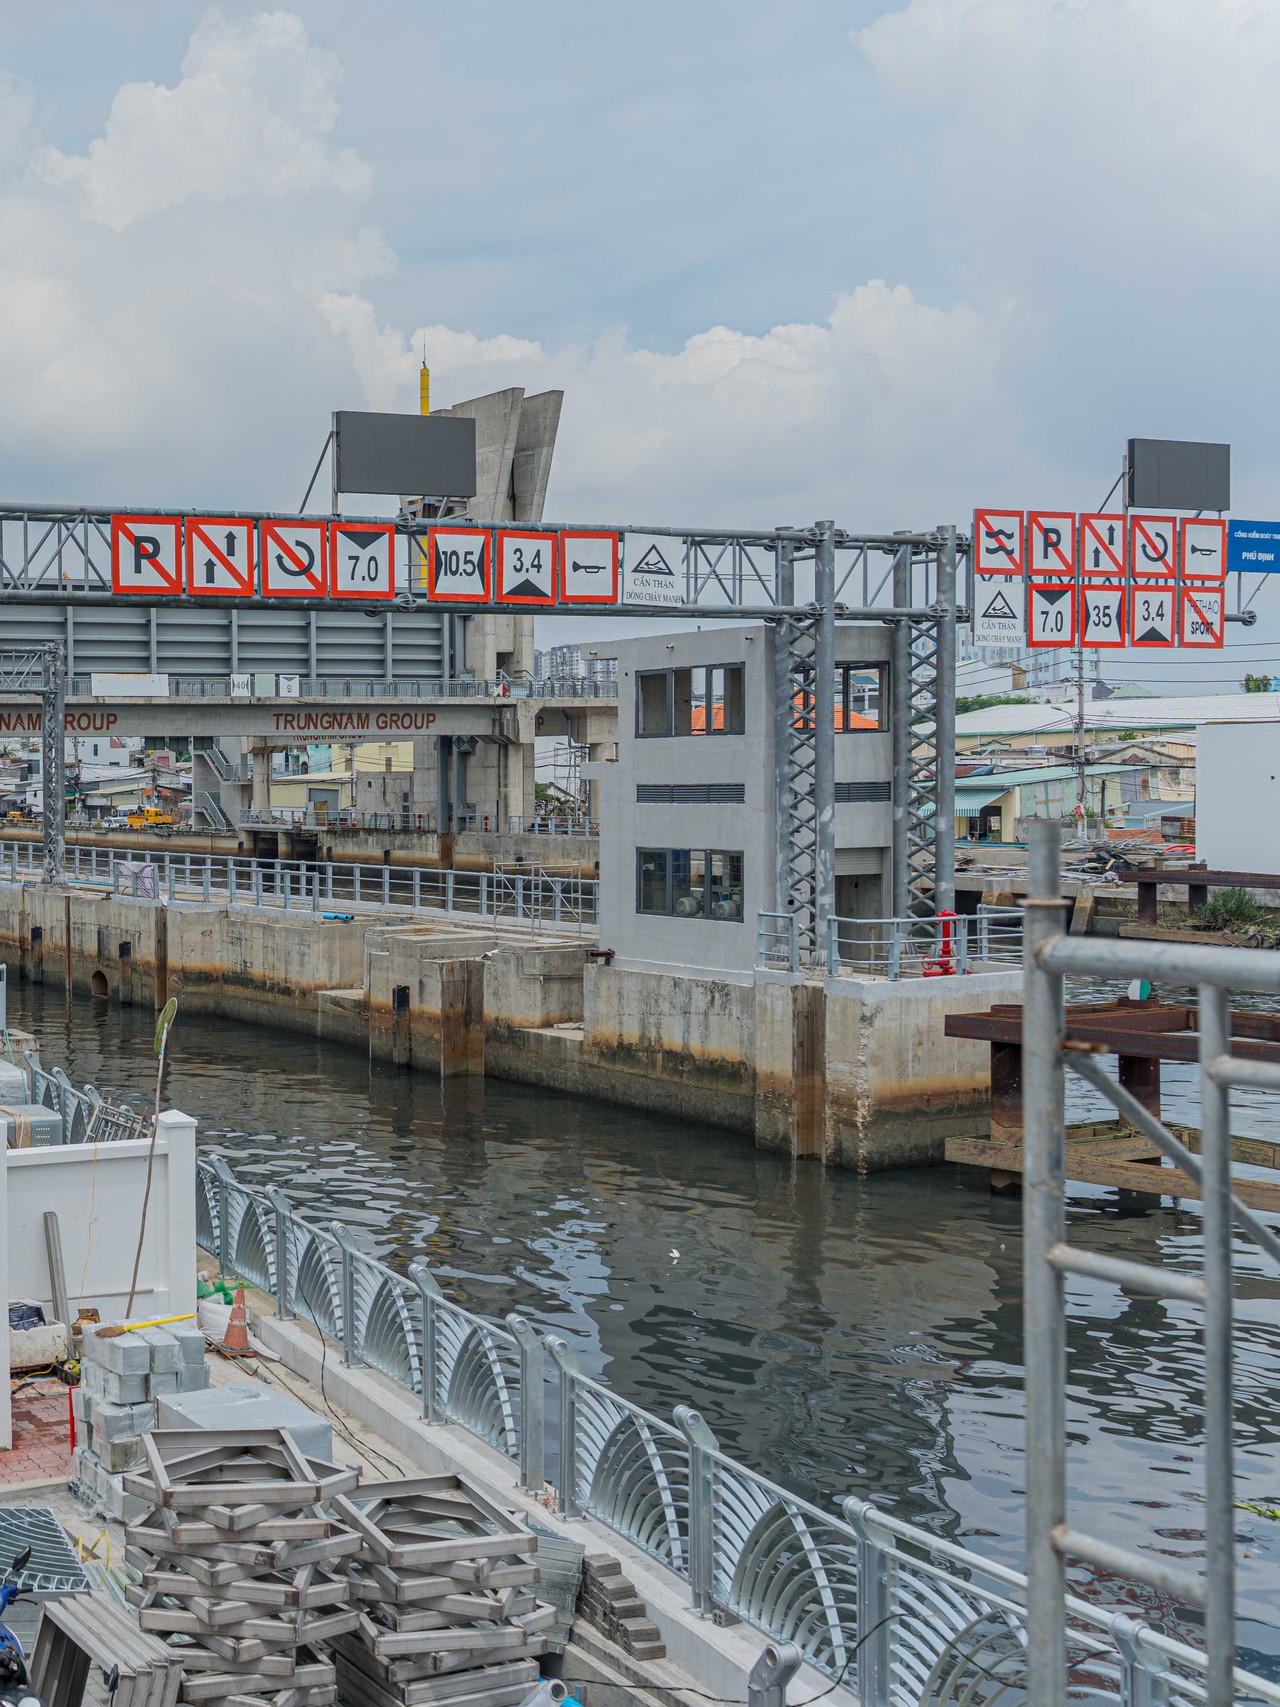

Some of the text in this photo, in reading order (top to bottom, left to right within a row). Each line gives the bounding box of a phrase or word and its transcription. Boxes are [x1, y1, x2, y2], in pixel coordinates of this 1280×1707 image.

[134, 535, 161, 574] P
[1043, 528, 1061, 559] P
[441, 550, 476, 577] 10.5
[513, 547, 542, 574] 3.4
[1242, 551, 1274, 562] PHÚ ĐỊNH
[348, 555, 379, 582] 7.0
[1041, 610, 1063, 633] 7.0
[1092, 605, 1112, 628] 35
[1142, 600, 1165, 622] 3.4
[1191, 621, 1213, 635] SPORT
[236, 681, 246, 689] 40
[286, 684, 292, 693] 9
[65, 712, 118, 731] ROUP
[272, 712, 437, 730] TRUNGNAM GROUP
